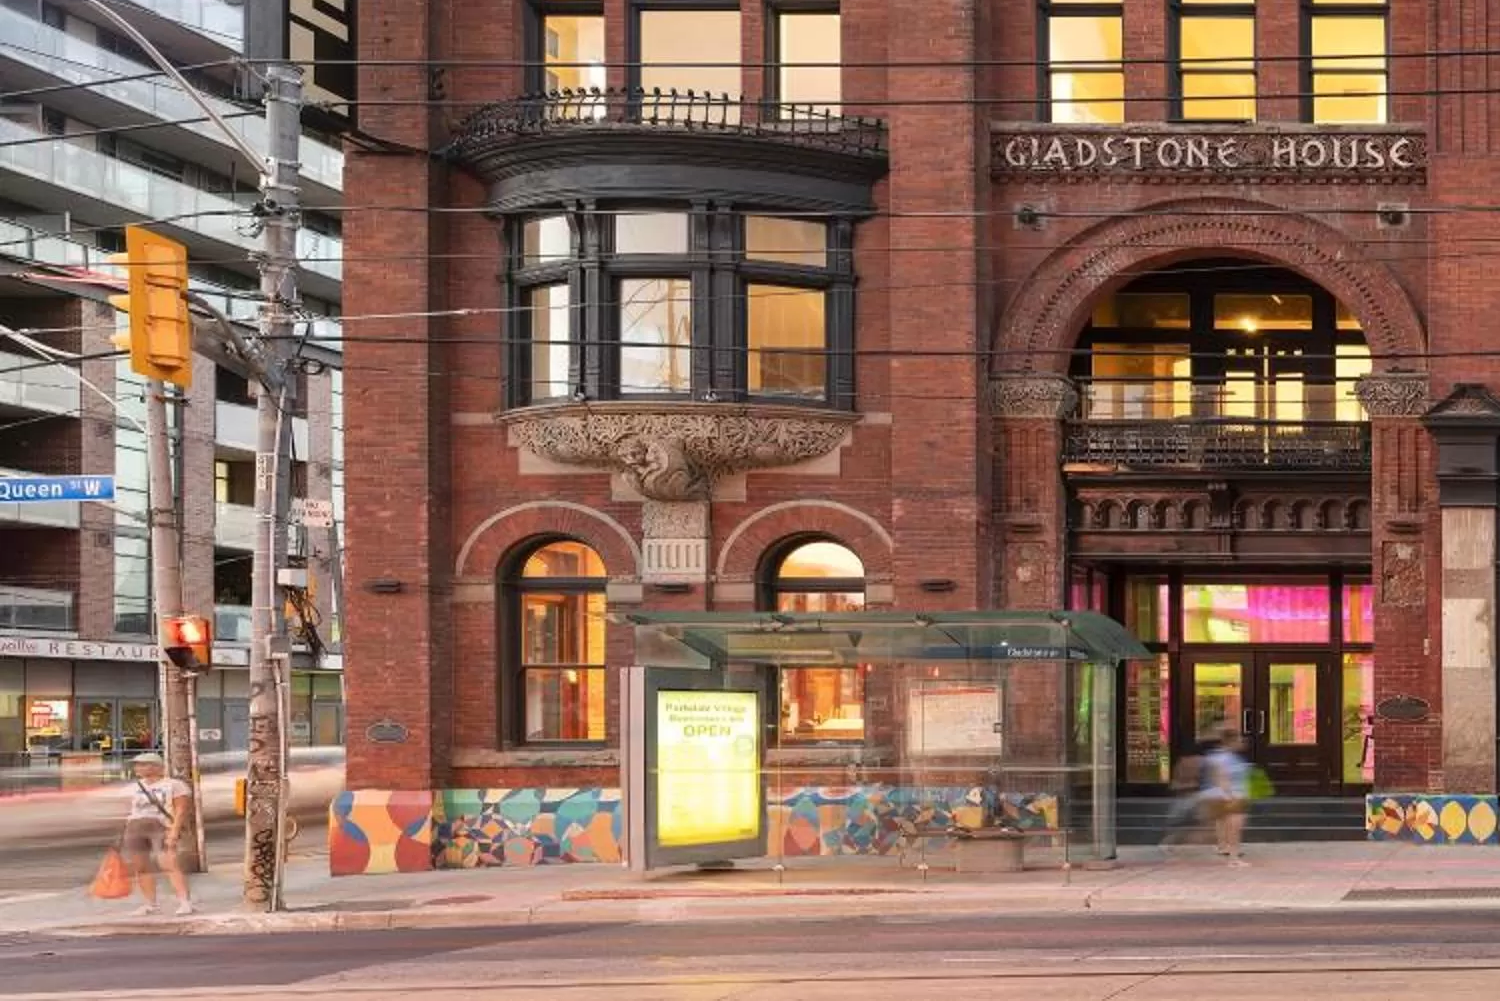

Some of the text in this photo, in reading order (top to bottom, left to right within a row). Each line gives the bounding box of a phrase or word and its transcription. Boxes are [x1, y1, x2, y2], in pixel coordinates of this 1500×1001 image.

[1004, 135, 1415, 169] GLADSTONE HOUSE
[0, 481, 63, 500] Queen
[84, 480, 100, 496] W
[49, 642, 160, 659] RESTAUR
[683, 724, 732, 737] OPEN
